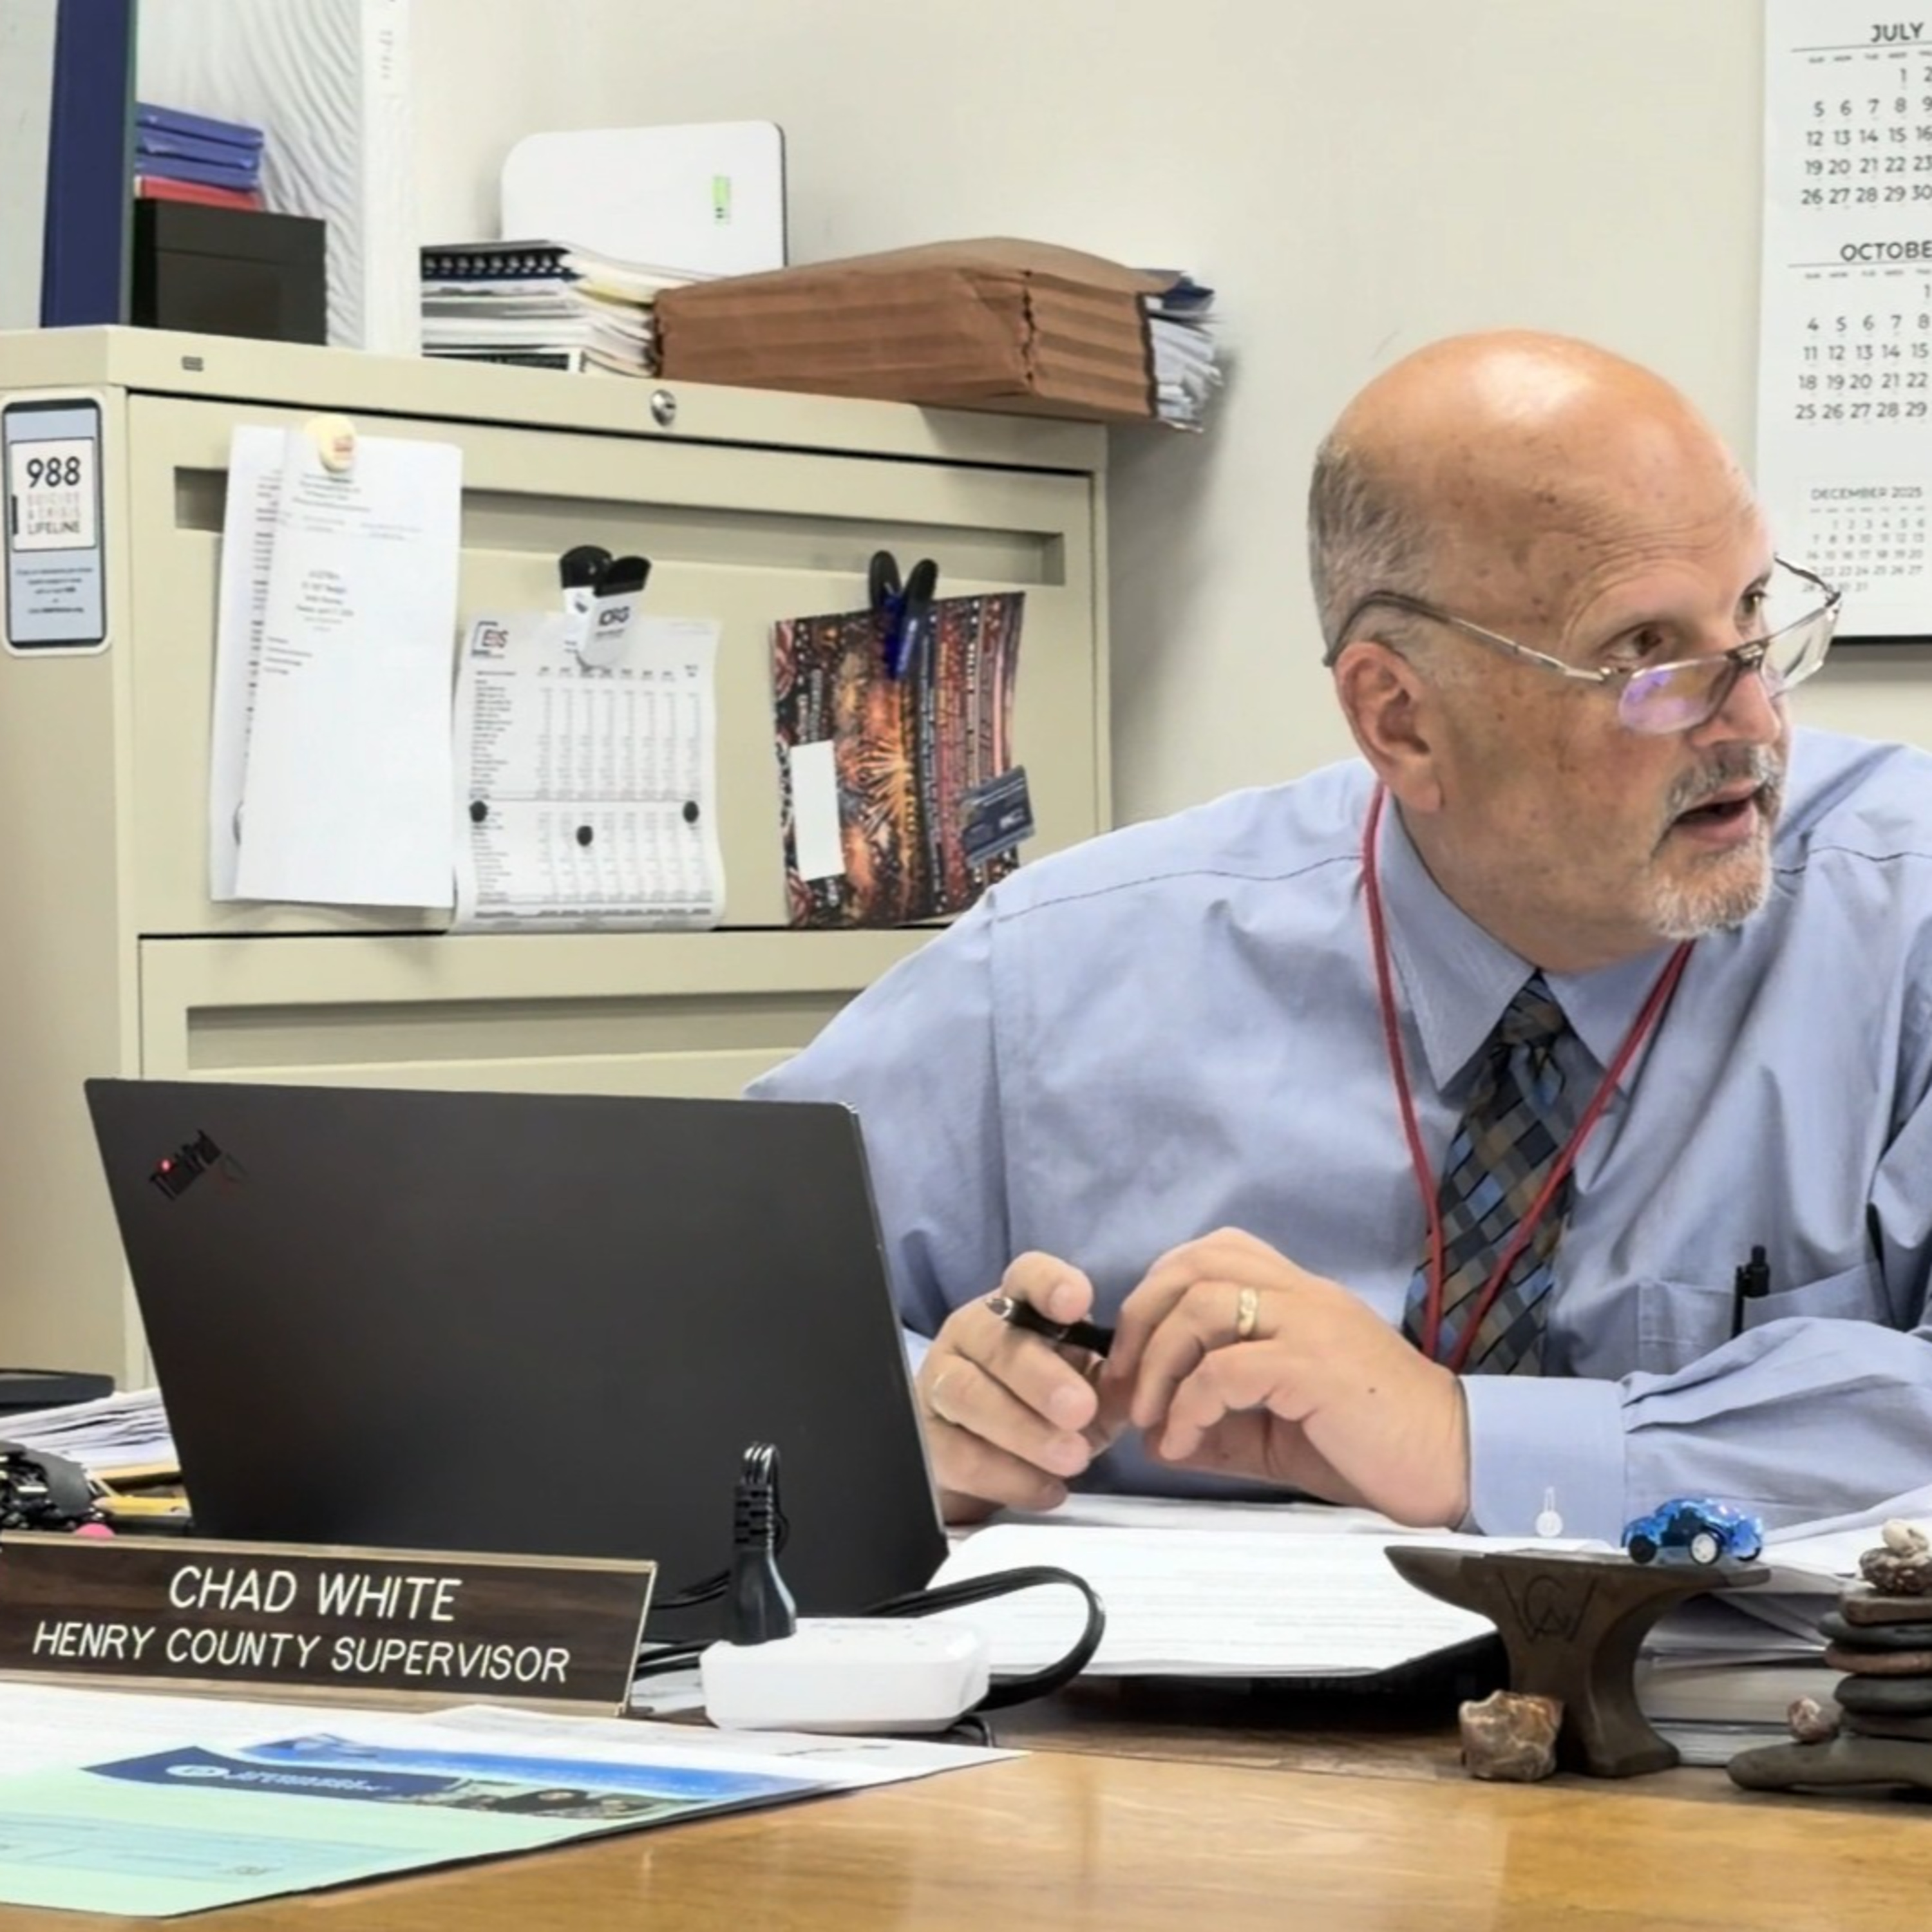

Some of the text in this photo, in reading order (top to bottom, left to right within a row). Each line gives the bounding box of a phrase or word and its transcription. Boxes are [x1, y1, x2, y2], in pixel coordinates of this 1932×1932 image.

[1871, 22, 1924, 43] JULY
[1900, 68, 1907, 83] 1
[1814, 95, 1932, 117] 5 6 7 8 9
[1806, 130, 1824, 147] 12
[1833, 129, 1851, 146] 13
[1859, 129, 1879, 144] 14
[1888, 127, 1907, 143] 15
[1805, 155, 1932, 176] 19 20 21 22 23
[1801, 184, 1932, 205] 26 27 28 29 30
[1924, 283, 1931, 299] 1
[1807, 313, 1930, 332] 4 5 6 7 8
[1804, 342, 1929, 361] 11 12 13 14 15
[1799, 372, 1928, 390] 18 19 20 21 22
[1795, 401, 1927, 420] 25 26 27 28 29
[26, 456, 81, 488] 988
[1811, 486, 1923, 501] DECEMBER 2025
[27, 520, 81, 535] LIFELINE
[149, 1129, 222, 1202] ThinkPad
[169, 1565, 462, 1621] CHAD WHITE
[32, 1620, 571, 1683] HENRY COUNTY SUPERVISOR
